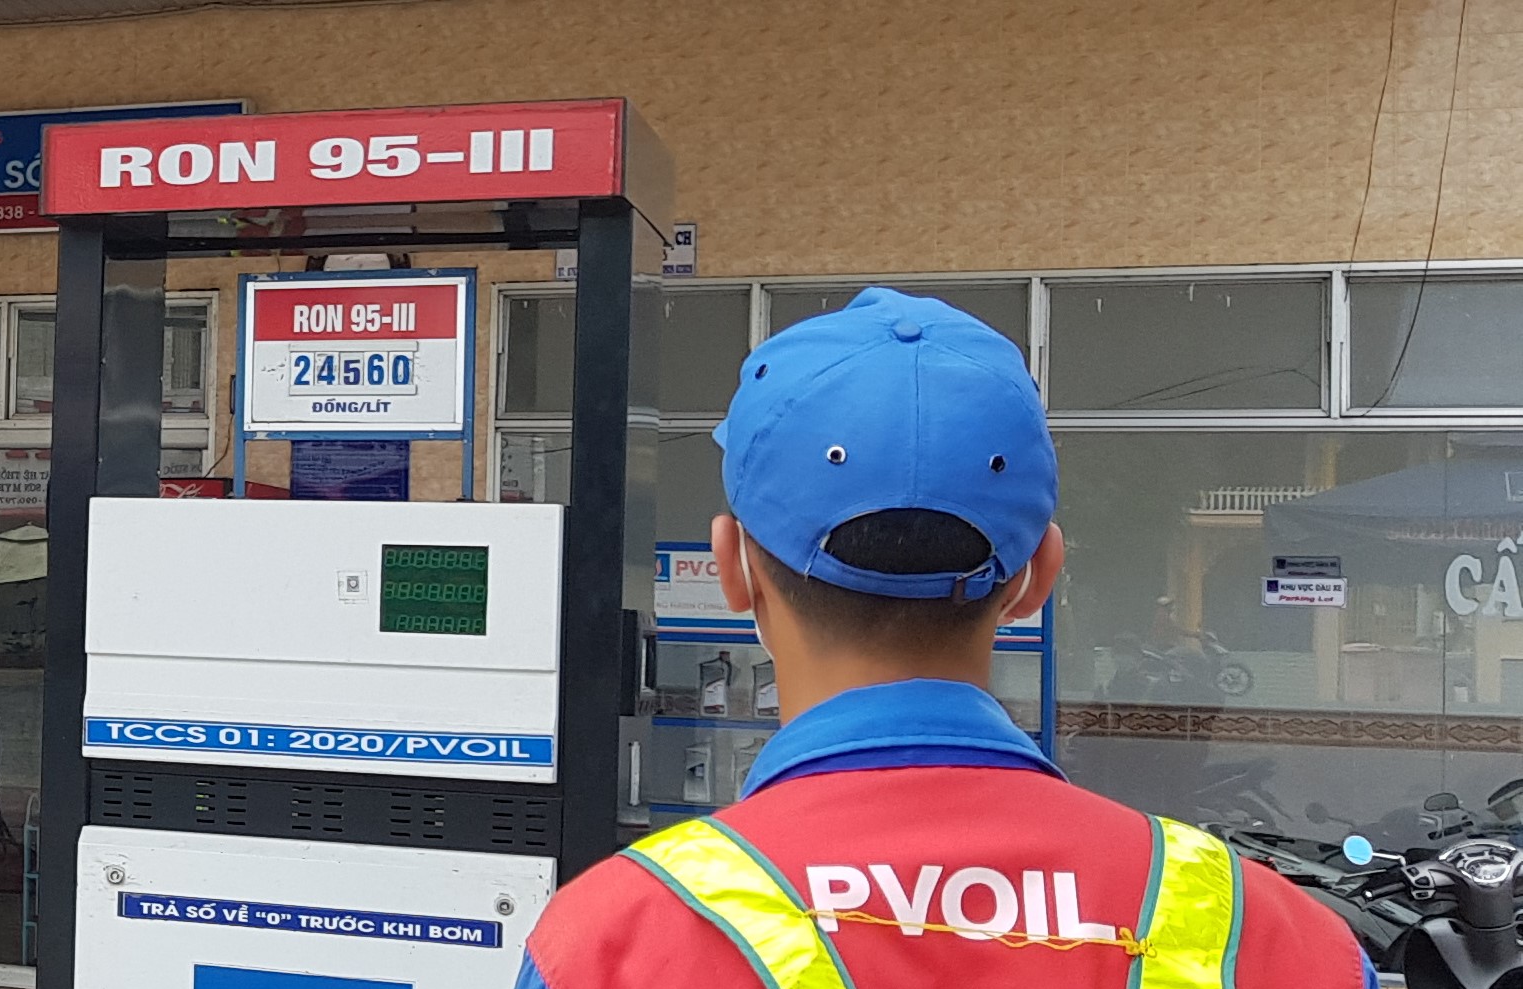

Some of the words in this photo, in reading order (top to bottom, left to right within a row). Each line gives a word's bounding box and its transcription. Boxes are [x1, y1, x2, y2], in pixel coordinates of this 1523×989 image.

[99, 140, 276, 188] RON
[309, 128, 554, 180] 95-III
[293, 305, 343, 333] RON
[350, 302, 416, 332] 95-III
[294, 354, 412, 386] 24560
[106, 722, 206, 745] TCCS
[218, 729, 276, 748] 01:
[288, 732, 531, 759] 2020/PVOIL
[140, 900, 180, 918] TRẢ
[185, 902, 217, 920] SỐ
[222, 904, 249, 923] VỀ
[297, 913, 375, 934] TRƯỚC
[383, 921, 421, 937] KHI
[429, 924, 483, 942] BƠM
[806, 864, 1116, 941] PVOIL
